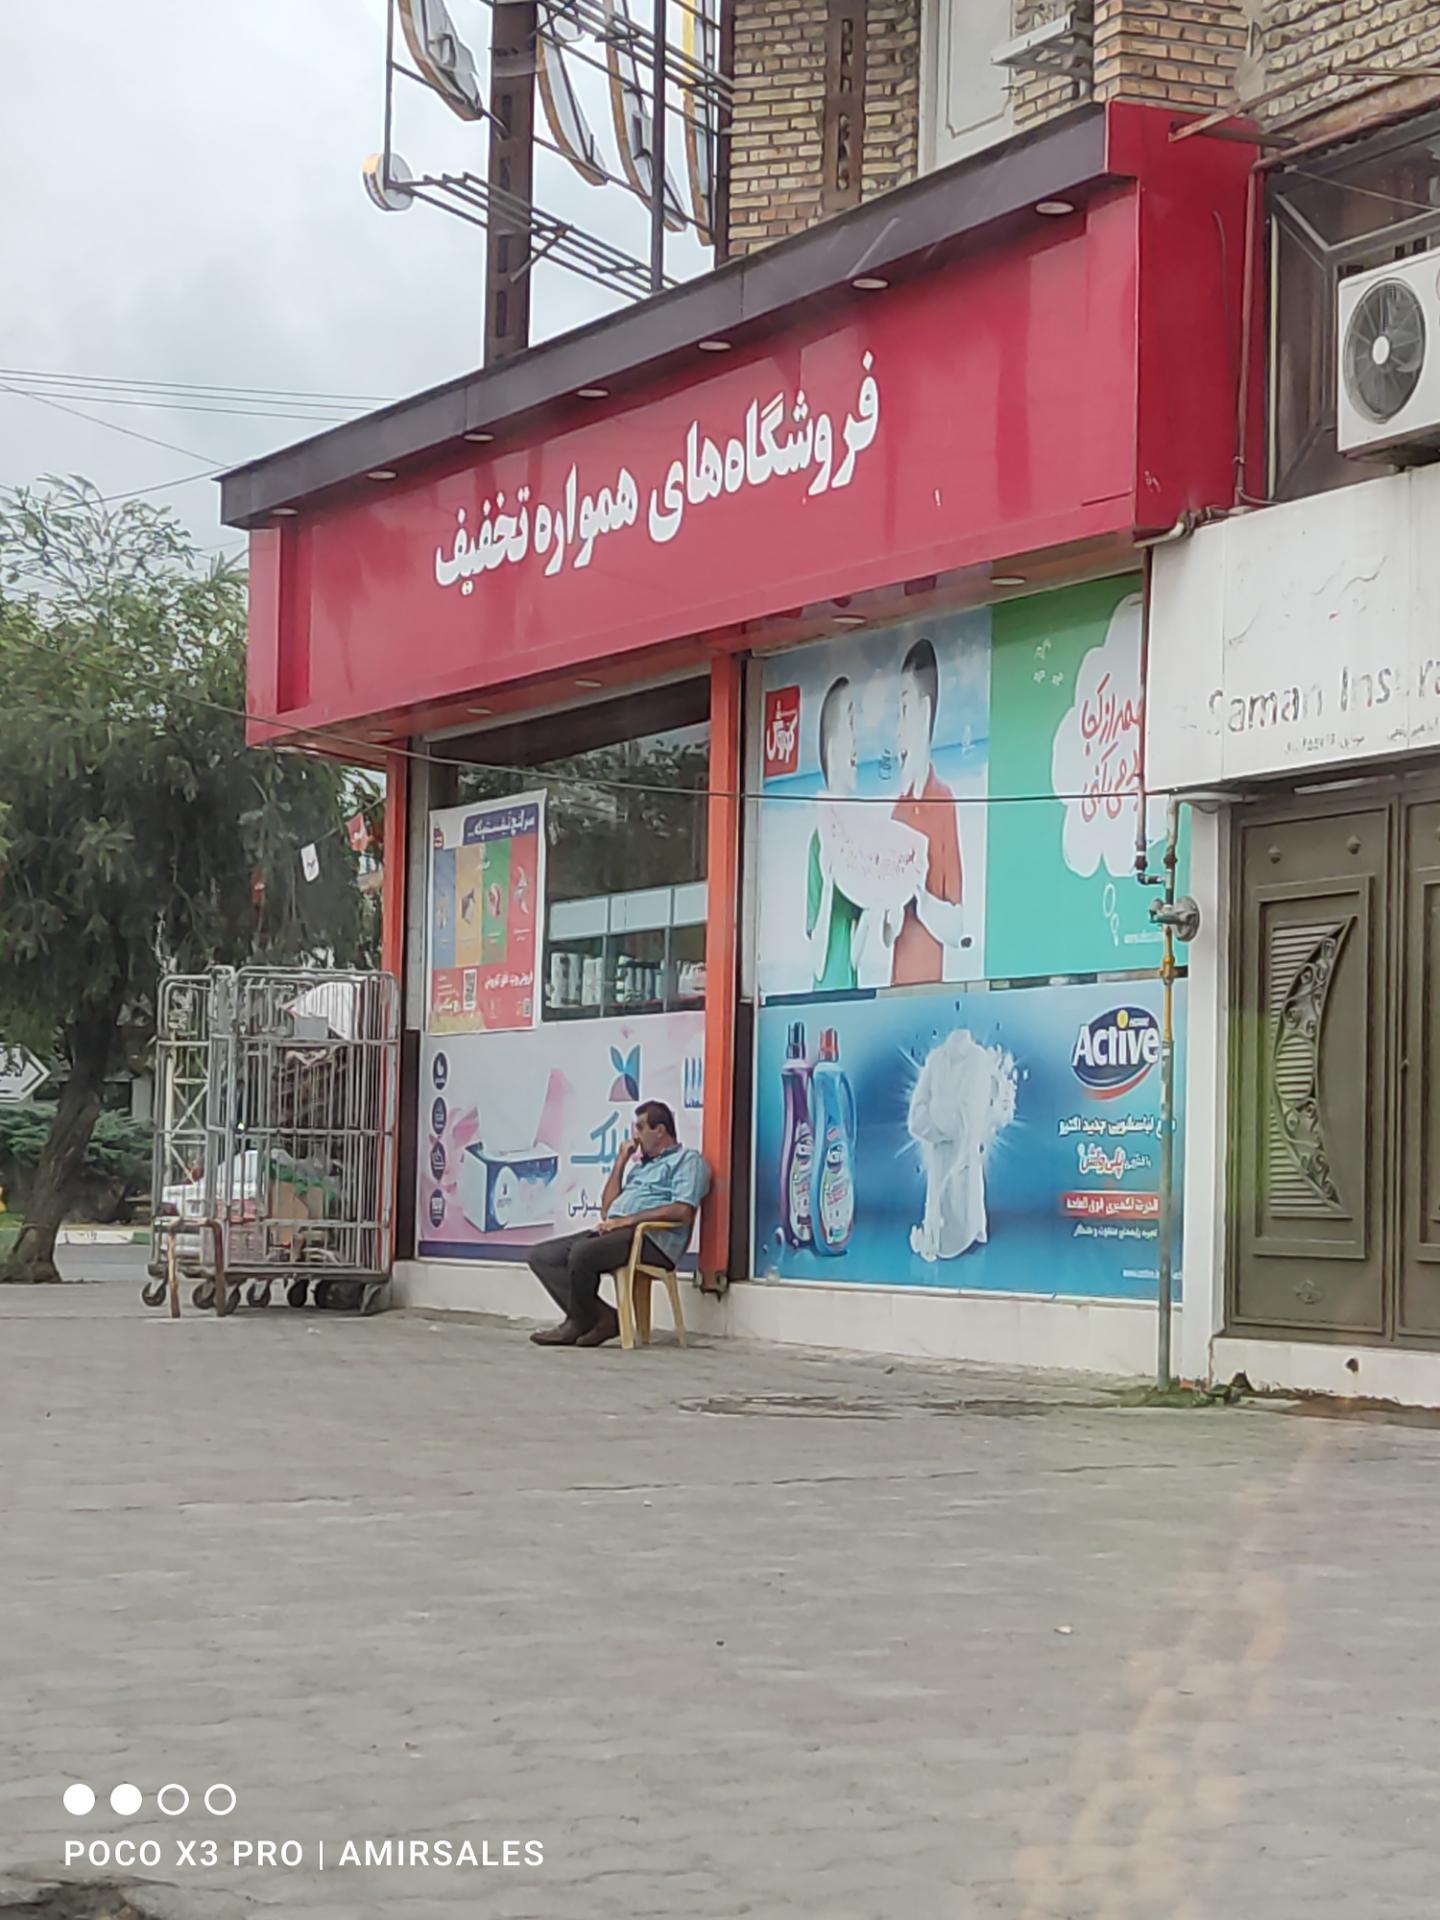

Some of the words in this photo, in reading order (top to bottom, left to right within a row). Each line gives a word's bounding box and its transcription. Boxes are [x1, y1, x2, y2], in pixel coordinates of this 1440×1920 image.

[434, 486, 530, 596] تخفیف
[534, 463, 638, 576] همواره
[1071, 1010, 1160, 1067] Active
